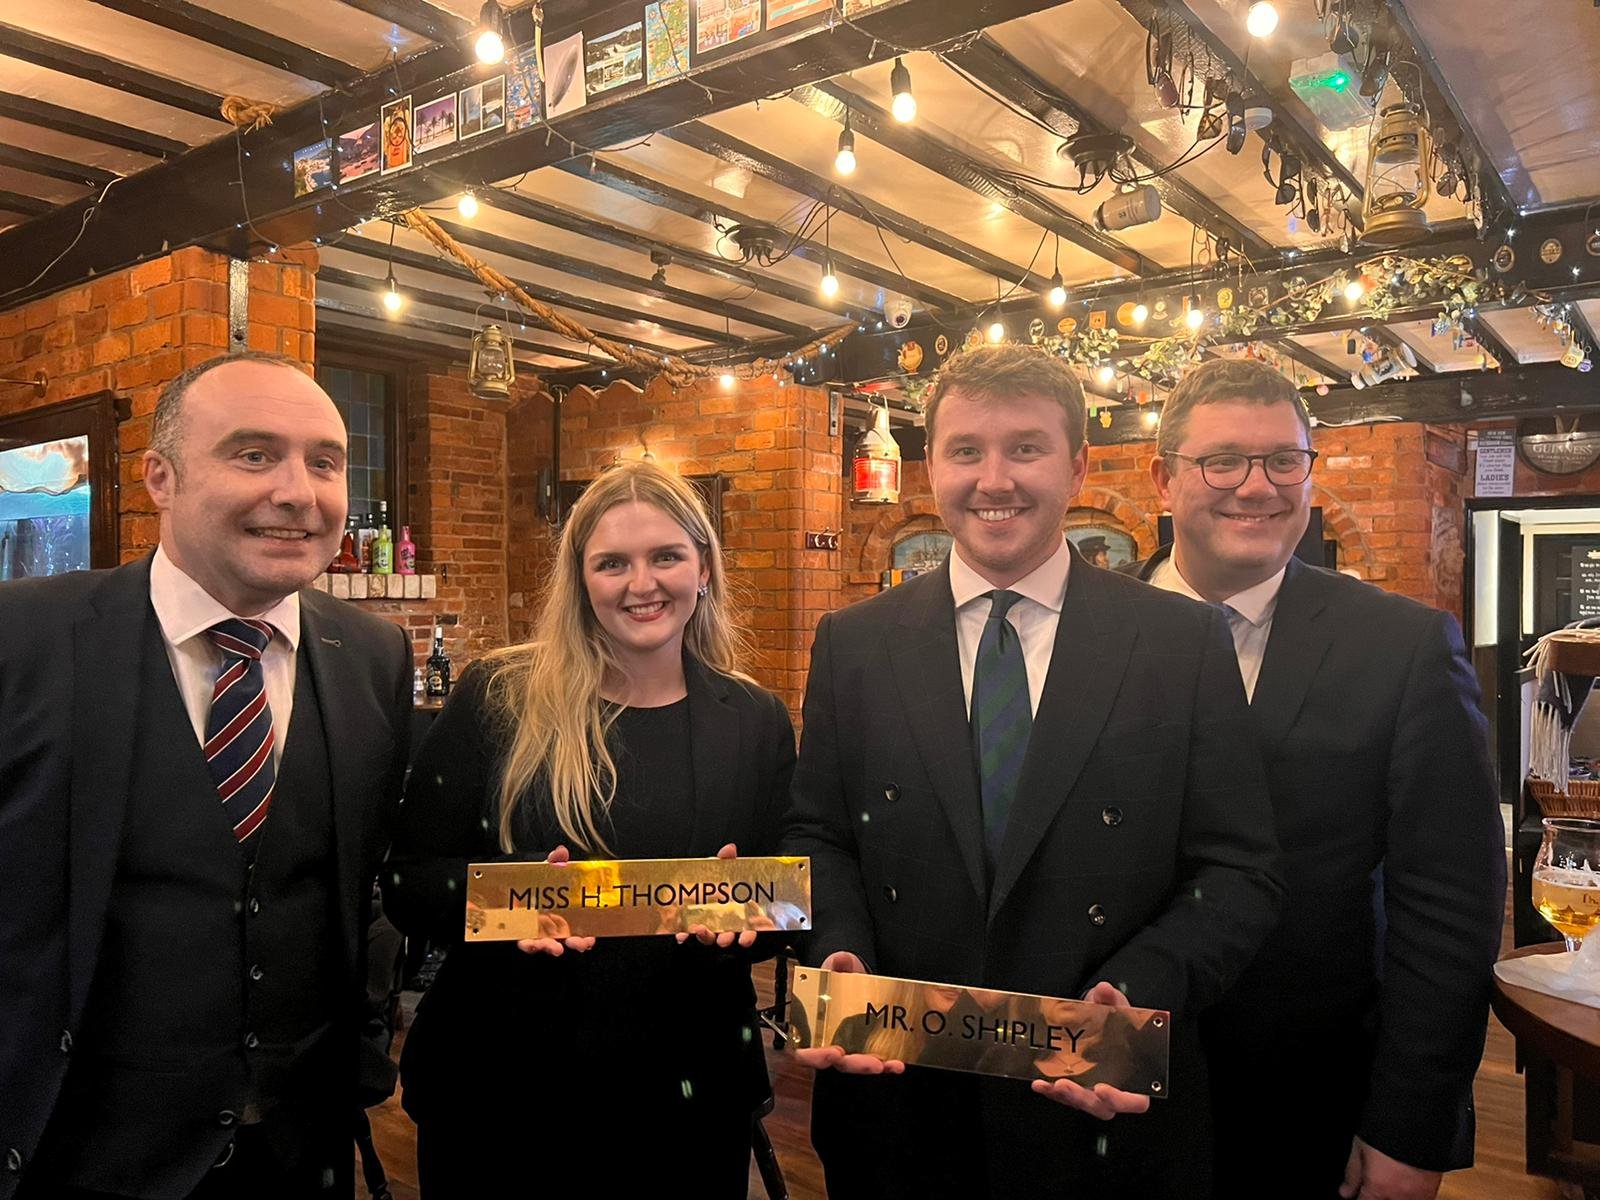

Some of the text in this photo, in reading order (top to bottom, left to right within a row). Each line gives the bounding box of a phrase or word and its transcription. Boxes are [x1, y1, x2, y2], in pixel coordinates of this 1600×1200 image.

[1532, 443, 1593, 456] GUINNESS
[508, 881, 775, 911] MISS H. THOMPSON
[865, 1002, 1086, 1054] MR. O. SHIPLEY
